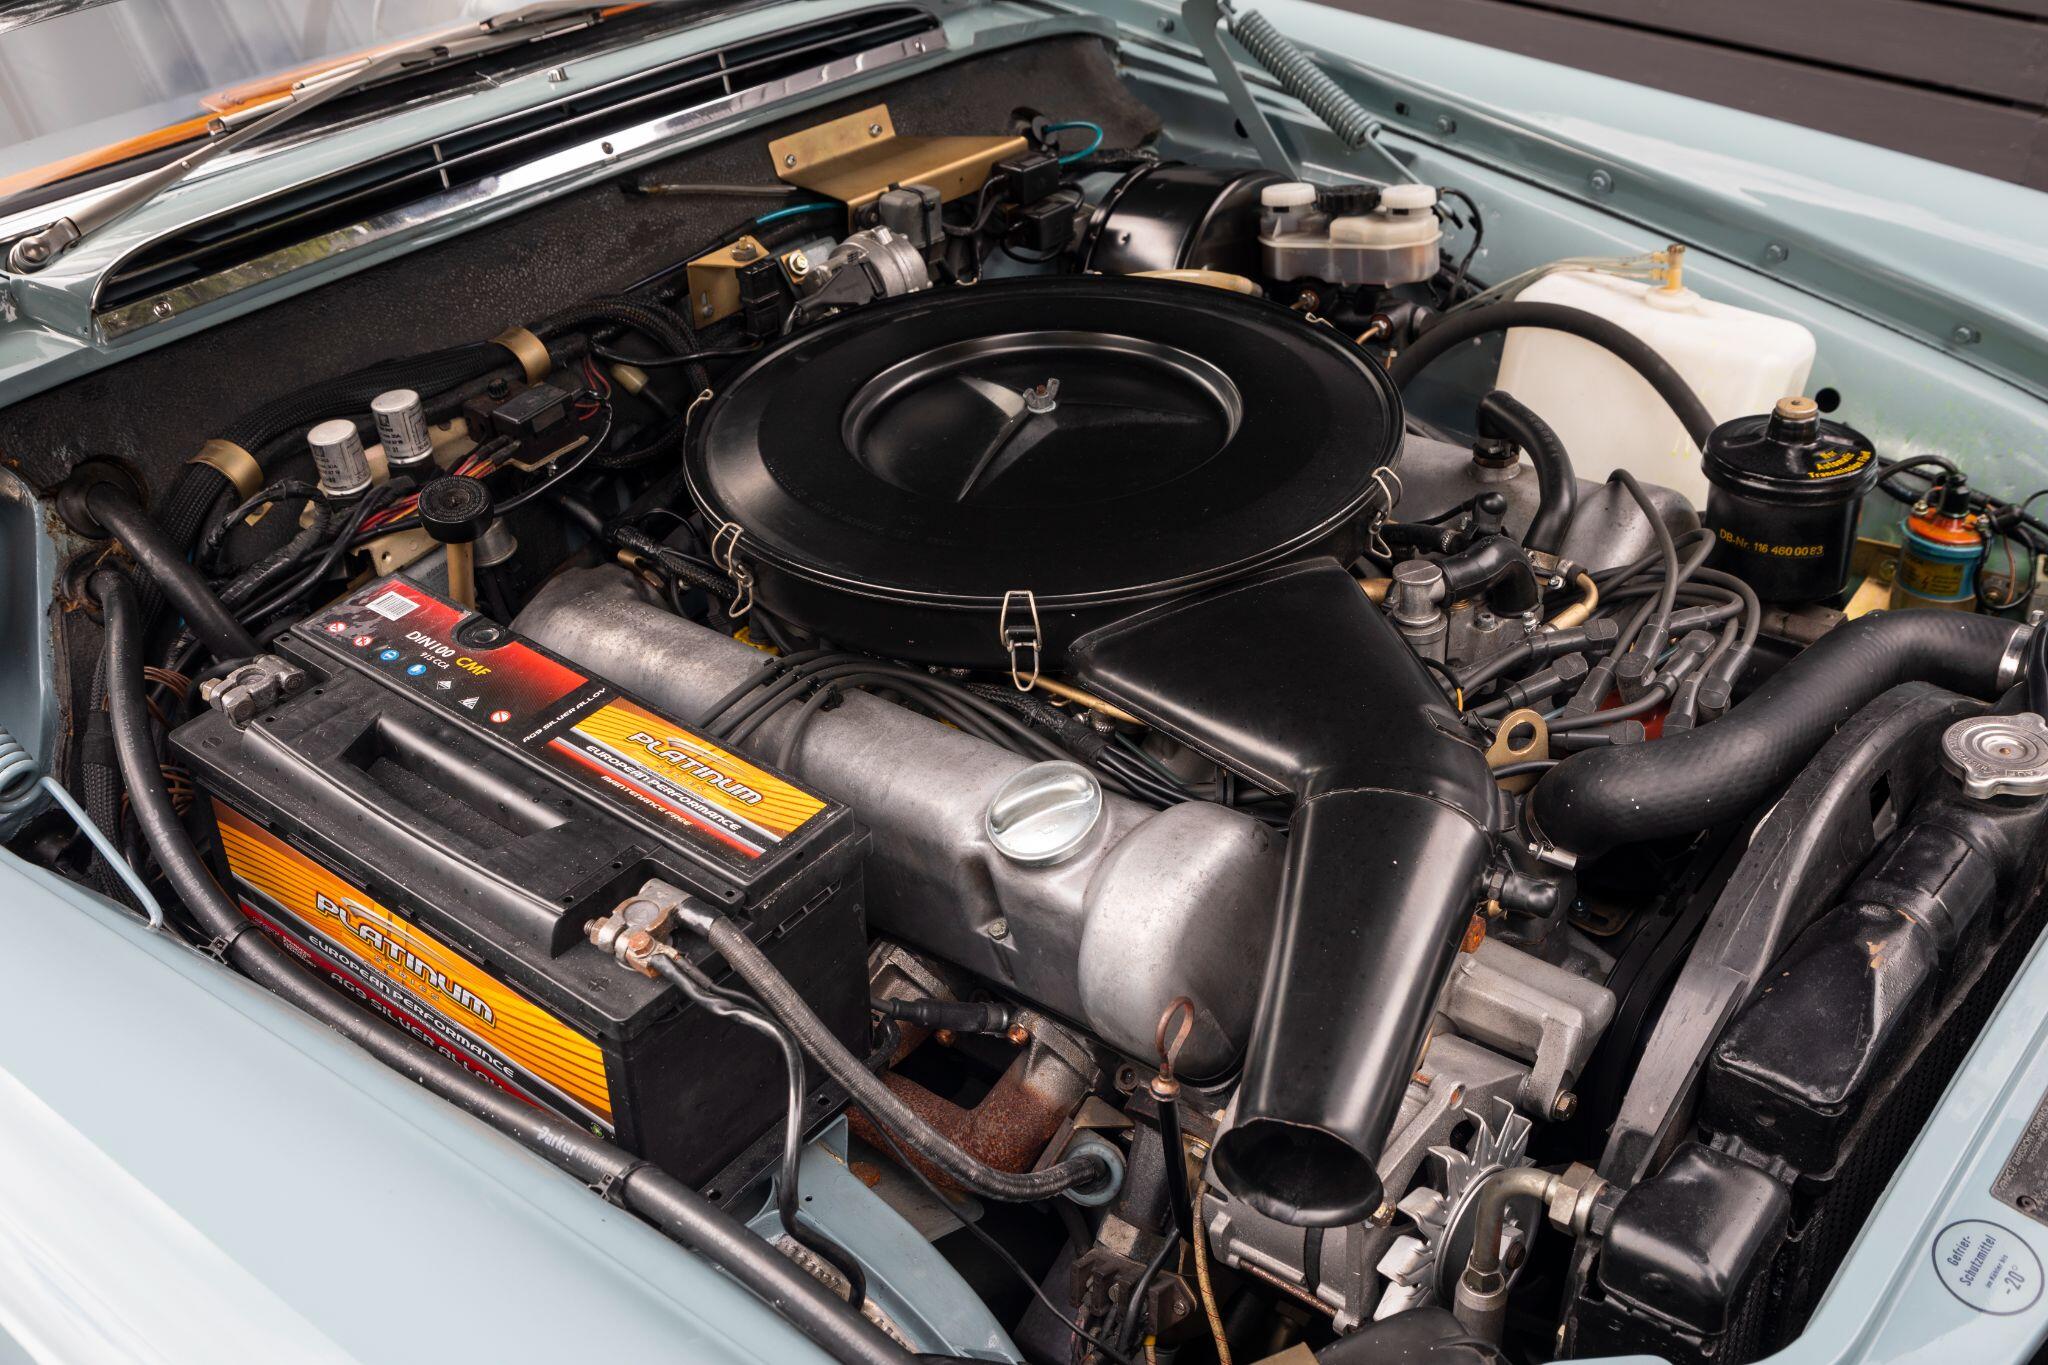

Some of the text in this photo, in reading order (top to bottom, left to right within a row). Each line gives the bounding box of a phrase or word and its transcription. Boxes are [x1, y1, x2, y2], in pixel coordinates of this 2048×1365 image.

[1808, 461, 1864, 478] Transmission
[1720, 528, 1750, 549] DB-Nr.
[1754, 542, 1768, 553] 116
[405, 630, 492, 676] DIN100 CMF
[433, 658, 450, 670] CCA
[522, 728, 543, 743] AG9
[576, 687, 606, 710] ALLOY
[586, 745, 650, 782] EUROPEAN
[649, 779, 742, 831] PERFORMANCE
[626, 731, 764, 807] PLATINUM
[601, 775, 666, 812] MAINTENANCE
[665, 809, 693, 827] FREE
[315, 891, 496, 1029] PLATINUM
[308, 935, 390, 994] EUROPEAN
[392, 990, 515, 1078] PERFORMANCE
[331, 972, 367, 1001] AG9
[537, 1126, 578, 1156] Parker
[1946, 1236, 1971, 1266] Gefrier-
[1959, 1234, 1996, 1287] Schutzmittel
